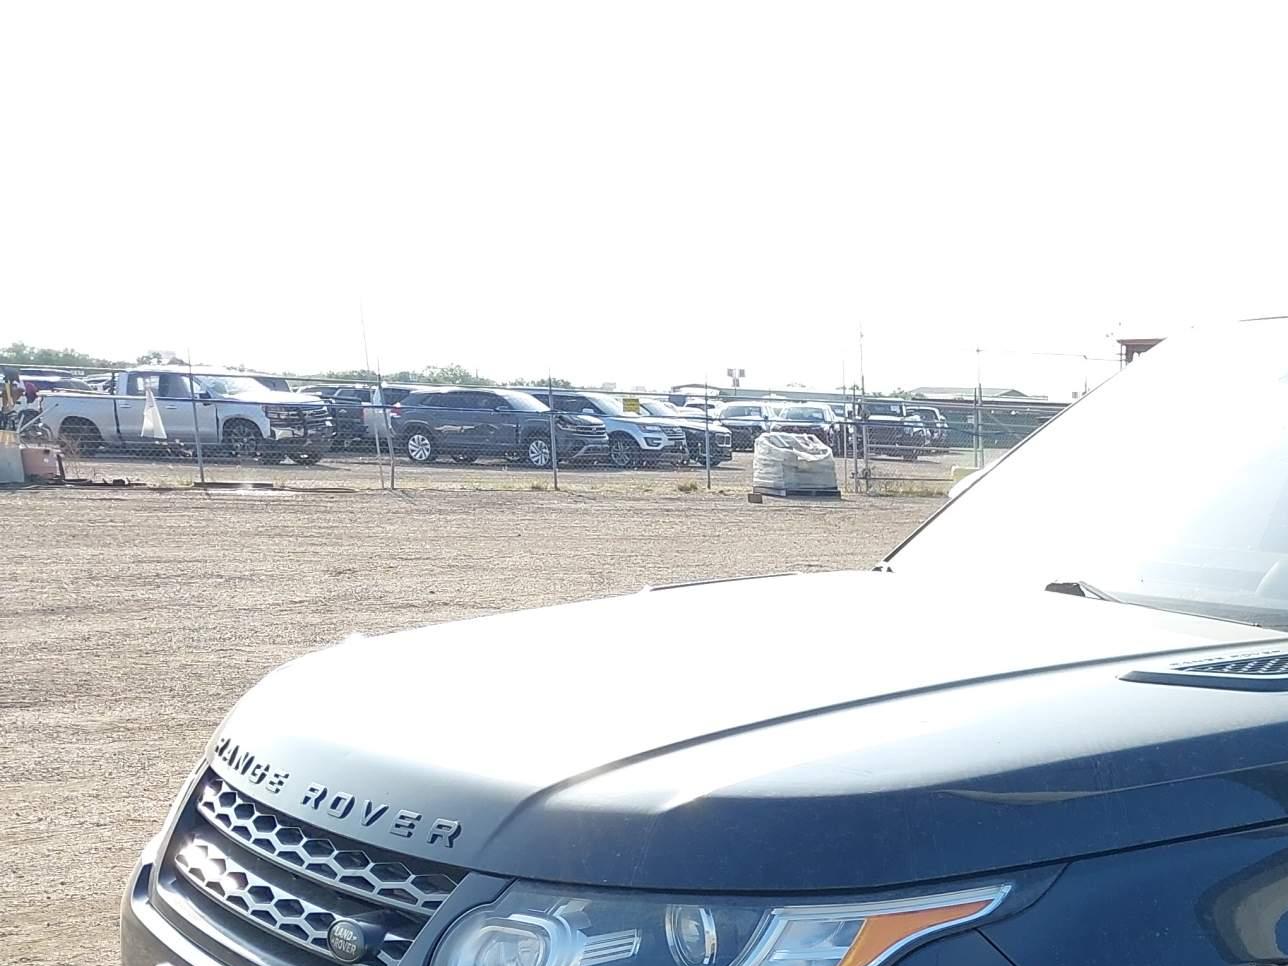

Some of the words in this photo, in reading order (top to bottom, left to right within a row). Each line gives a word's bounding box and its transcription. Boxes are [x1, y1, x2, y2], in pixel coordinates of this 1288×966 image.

[301, 781, 463, 849] ROVER
[334, 926, 354, 941] LAND
[334, 938, 357, 955] ROVER
